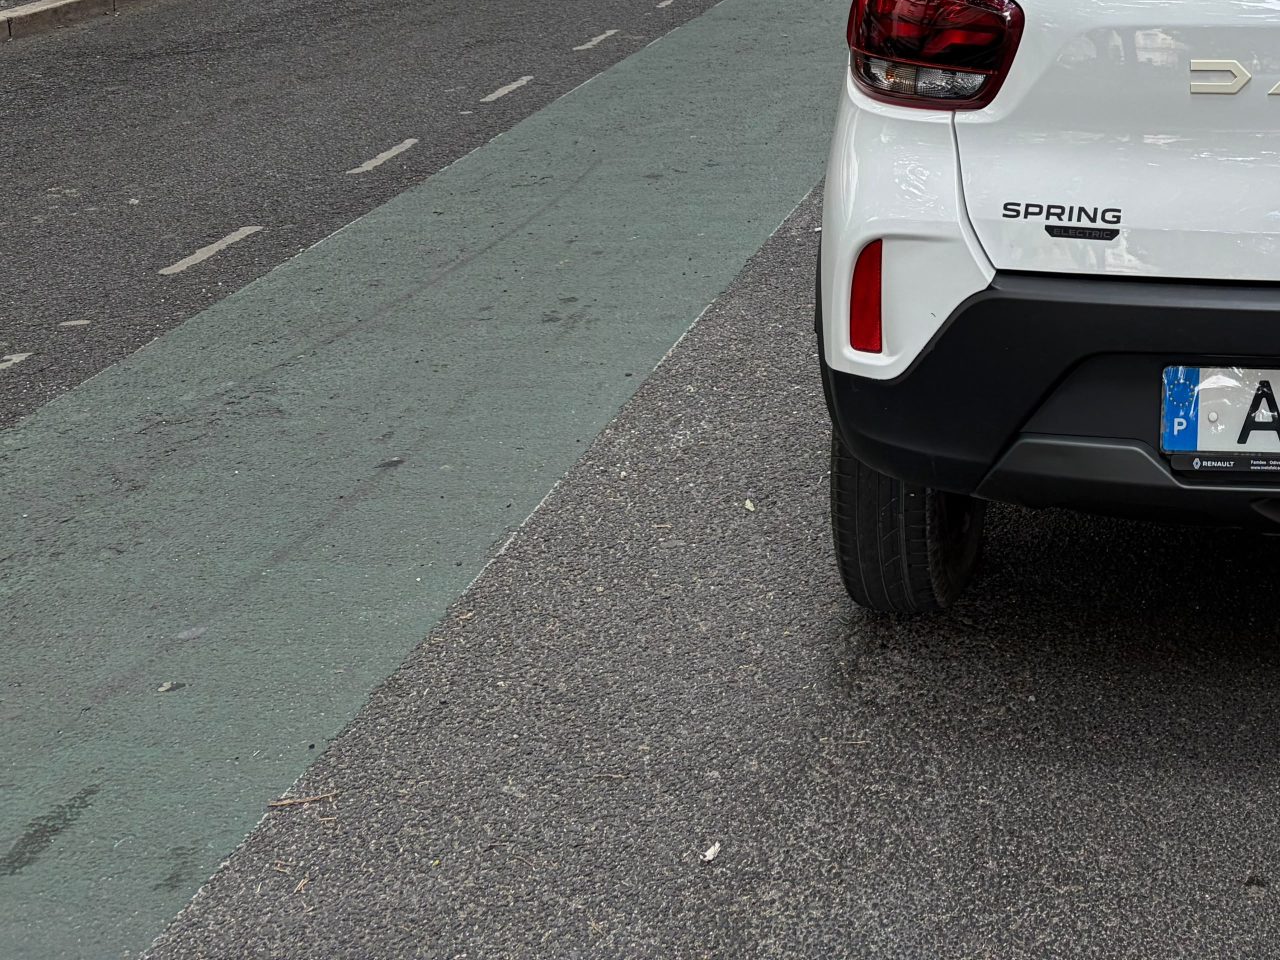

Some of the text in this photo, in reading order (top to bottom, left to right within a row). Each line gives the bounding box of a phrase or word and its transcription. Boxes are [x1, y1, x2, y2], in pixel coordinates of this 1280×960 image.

[1002, 202, 1122, 225] SPRING
[1053, 228, 1112, 238] ELECTRIC
[1173, 418, 1187, 436] P
